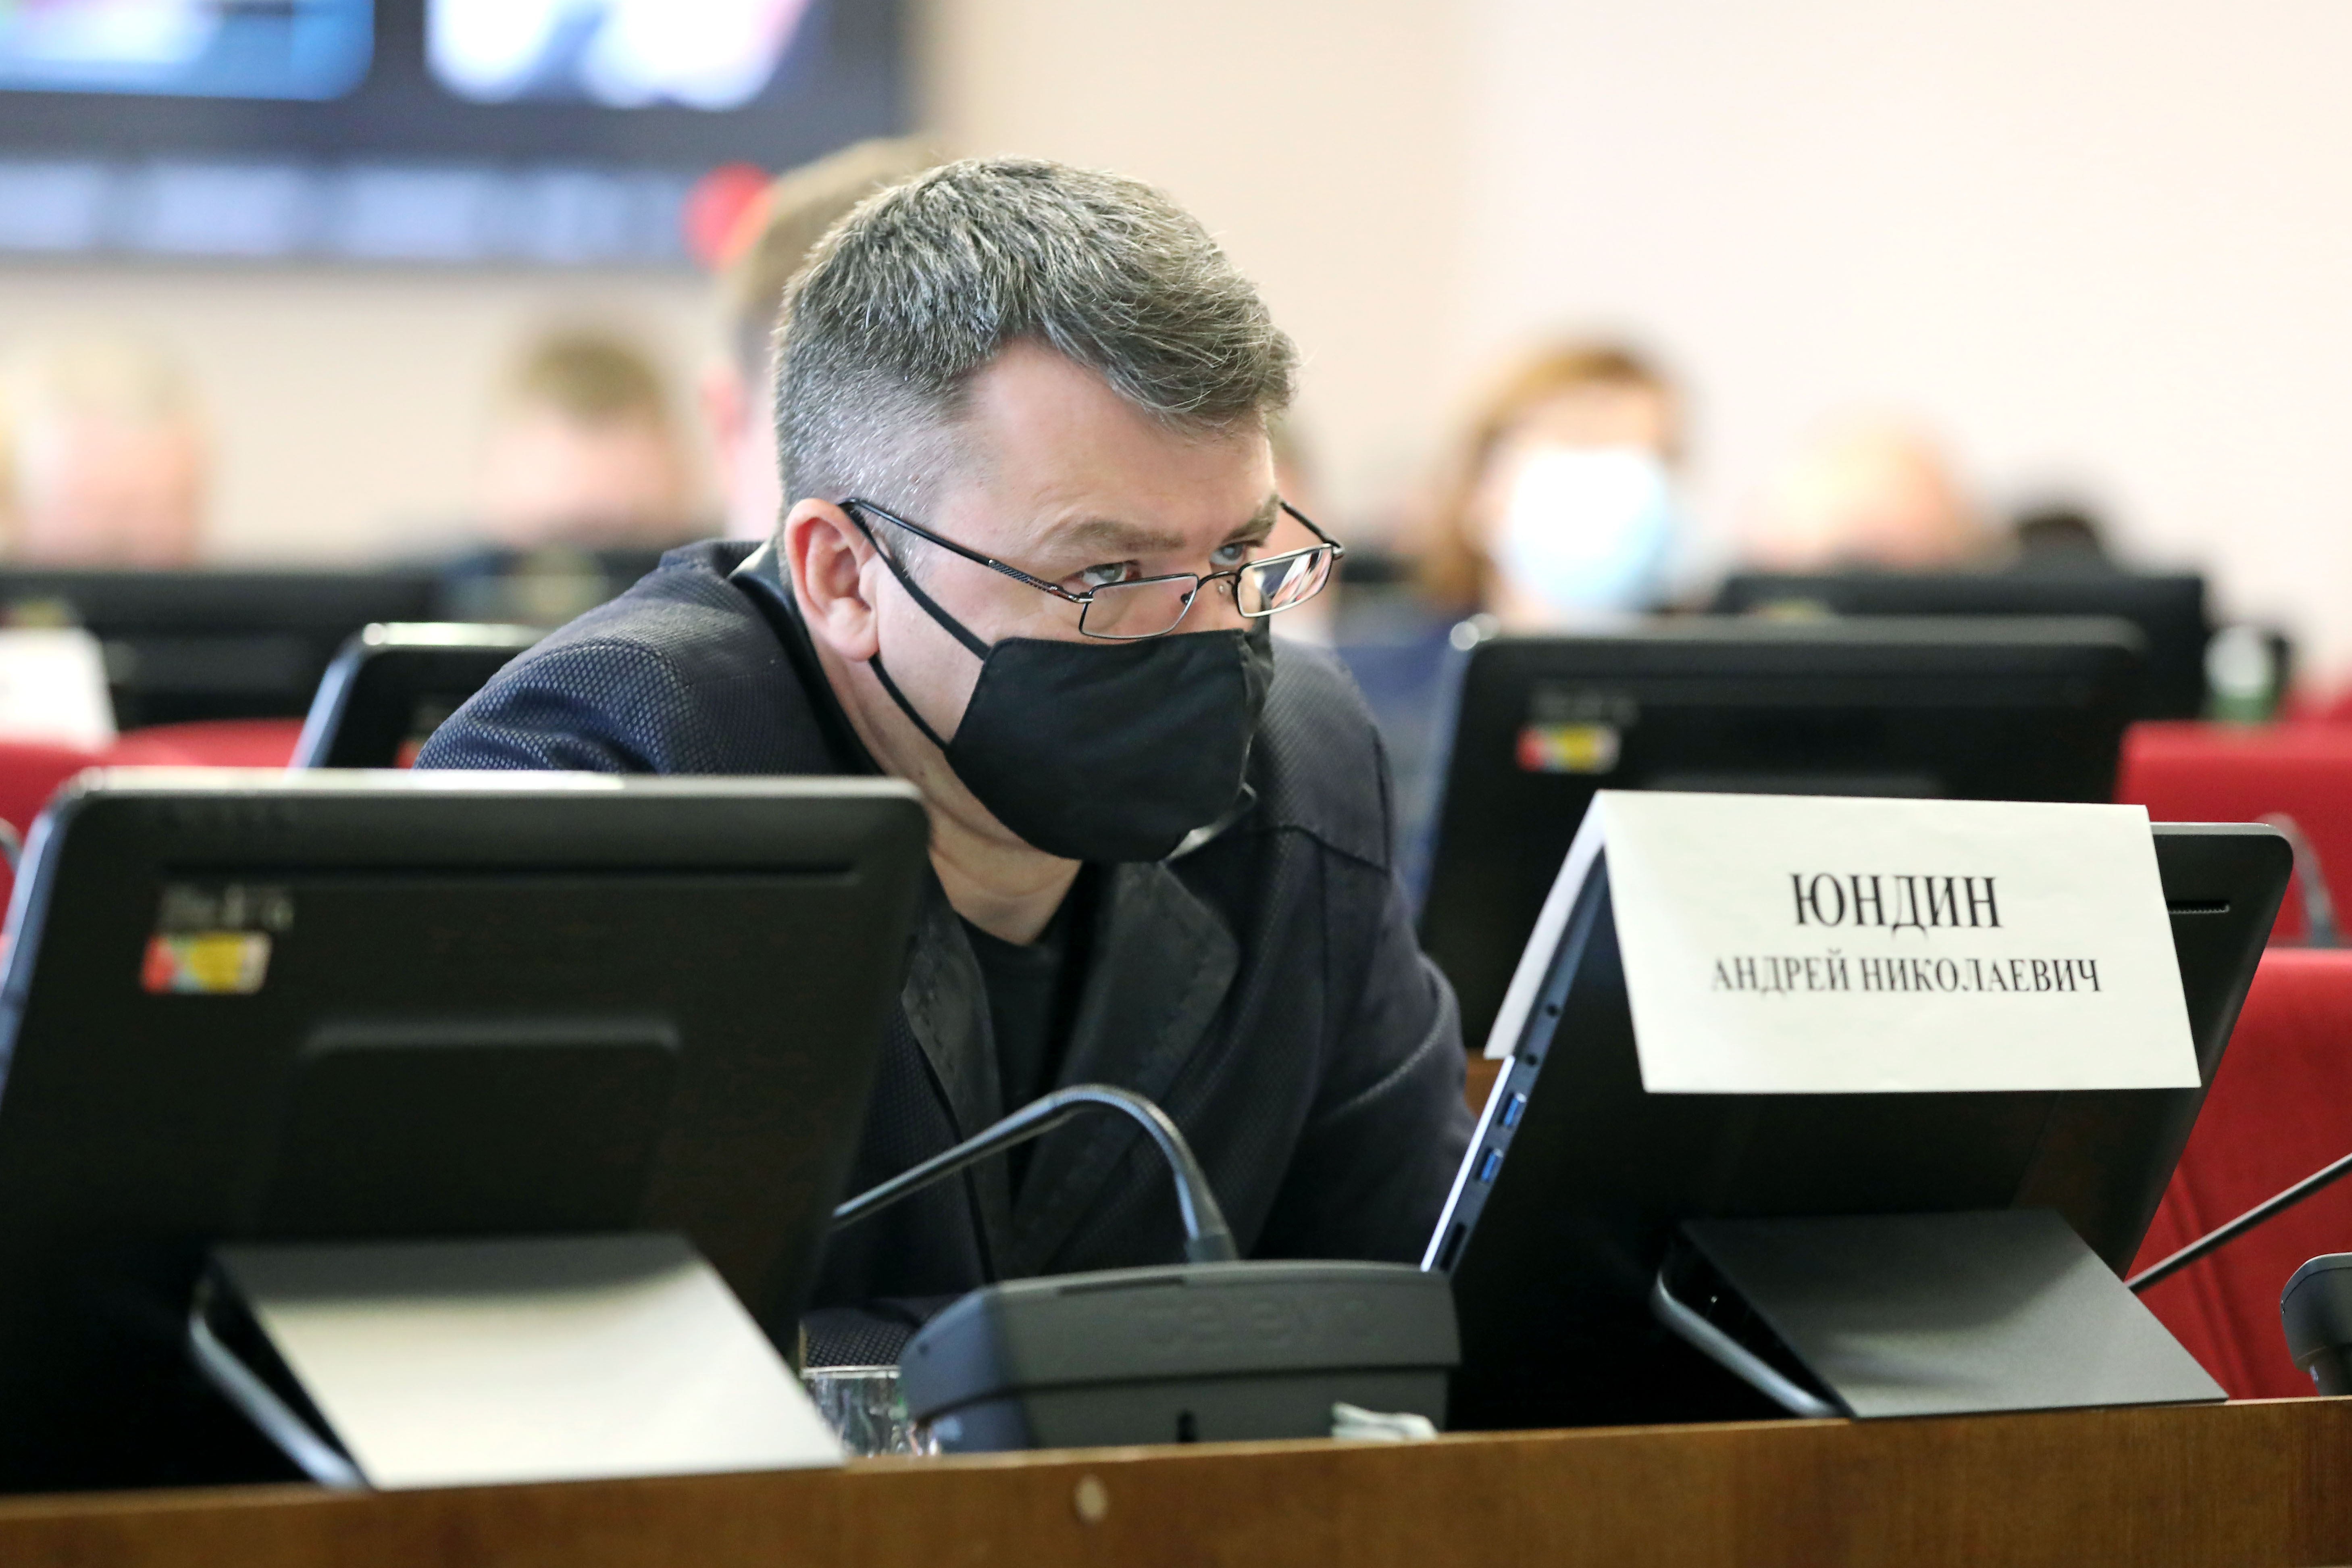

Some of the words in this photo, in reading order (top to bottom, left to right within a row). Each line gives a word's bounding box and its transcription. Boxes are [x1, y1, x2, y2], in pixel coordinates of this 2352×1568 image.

[1789, 872, 2003, 938] ЮНДИН
[1713, 949, 1850, 996] АНДРЕЙ
[1859, 957, 2101, 992] НИКОЛАЕВИЧ
